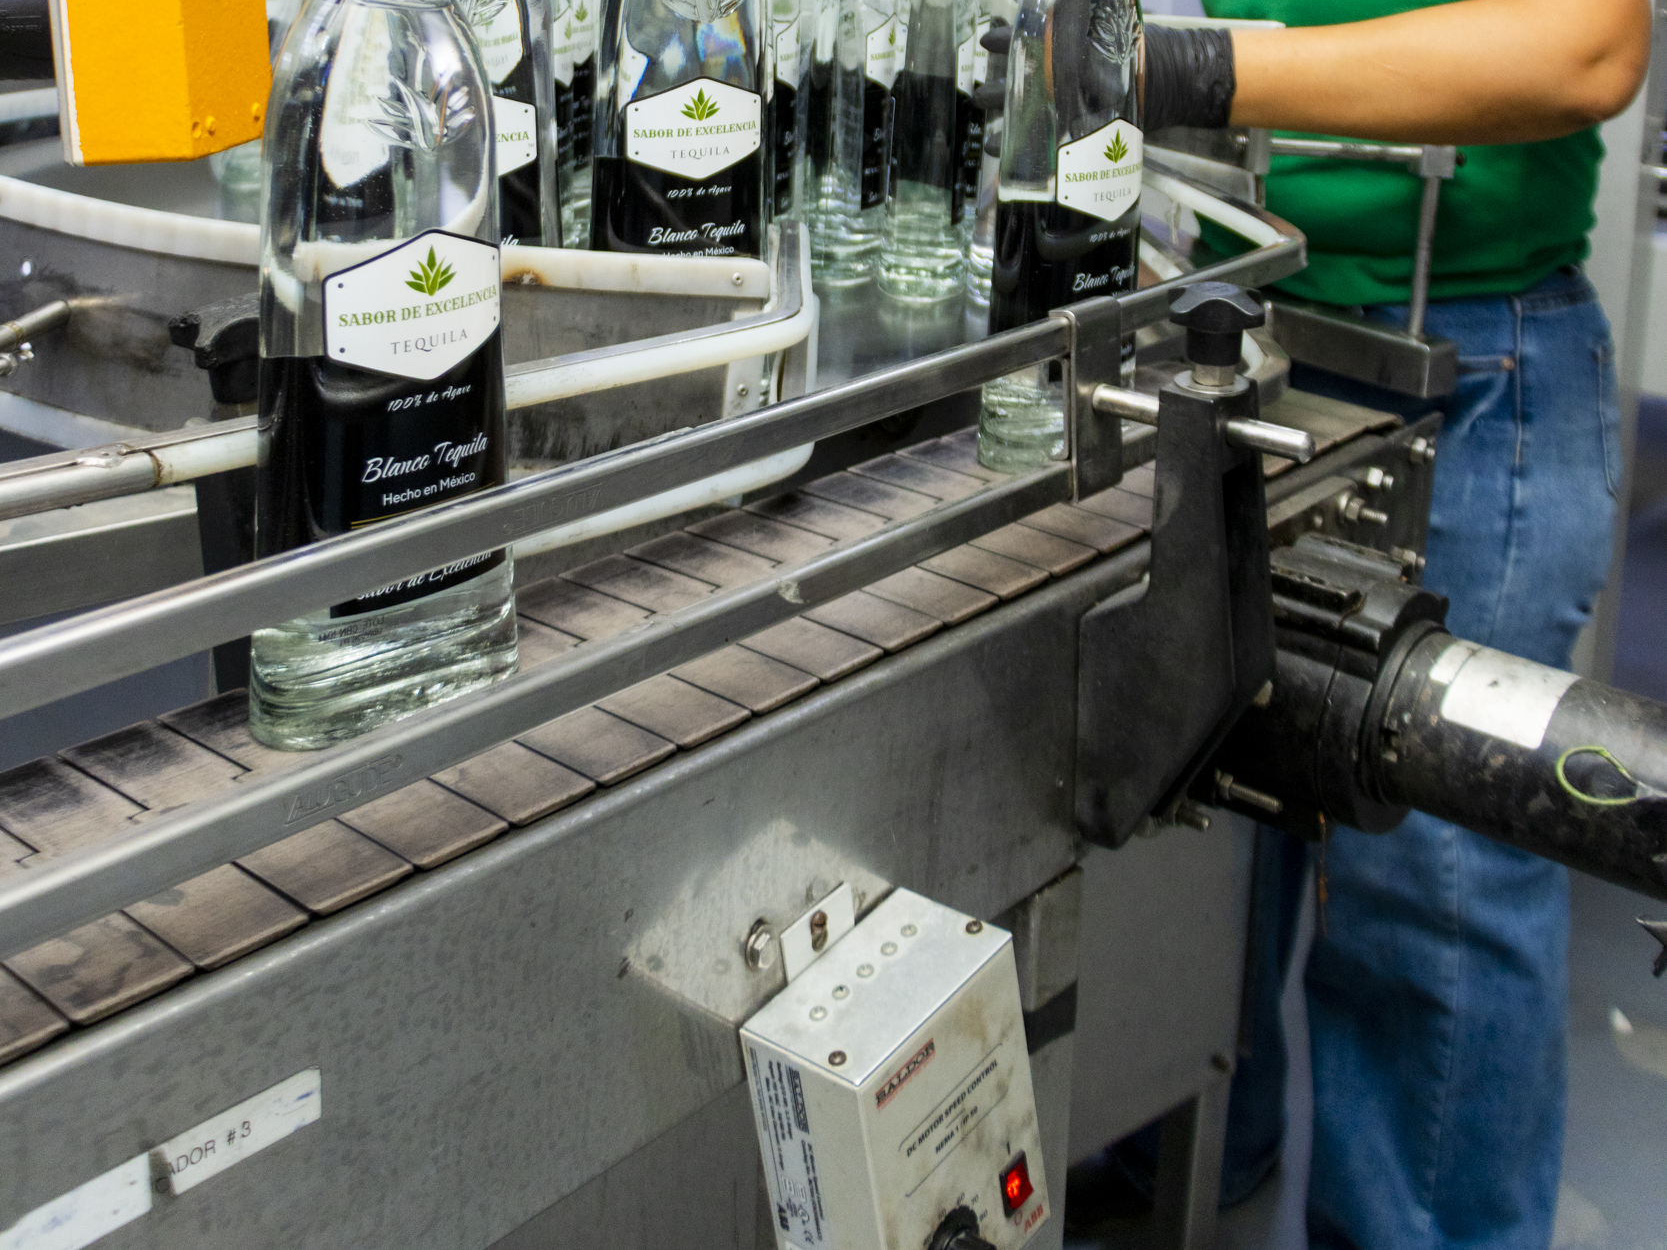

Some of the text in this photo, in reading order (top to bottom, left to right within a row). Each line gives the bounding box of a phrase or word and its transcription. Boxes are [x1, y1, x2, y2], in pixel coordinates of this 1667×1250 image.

[495, 131, 530, 143] ENCIA
[633, 120, 757, 139] SABOR DE EXCELENCIA
[670, 146, 730, 160] TEQUILA
[1065, 170, 1098, 183] SABOR
[1100, 170, 1111, 180] DE
[666, 187, 694, 199] 100%
[696, 186, 706, 196] de
[1094, 187, 1132, 202] TEQUILA
[647, 220, 746, 246] Blanco Tequila
[705, 245, 734, 257] México
[1072, 272, 1109, 292] Blanco
[338, 284, 498, 328] SABOR DE EXCELENCIA
[390, 328, 468, 354] TEQUILA
[387, 384, 472, 411] 100% de Agave
[361, 432, 489, 483] Blanco Tequila
[382, 472, 476, 506] Hecho en México
[875, 1040, 936, 1107] BALDOR
[906, 1059, 998, 1158] DC MOTOR SPEED CONTROL
[935, 1130, 956, 1154] NEMA
[1024, 1204, 1044, 1234] ABB
